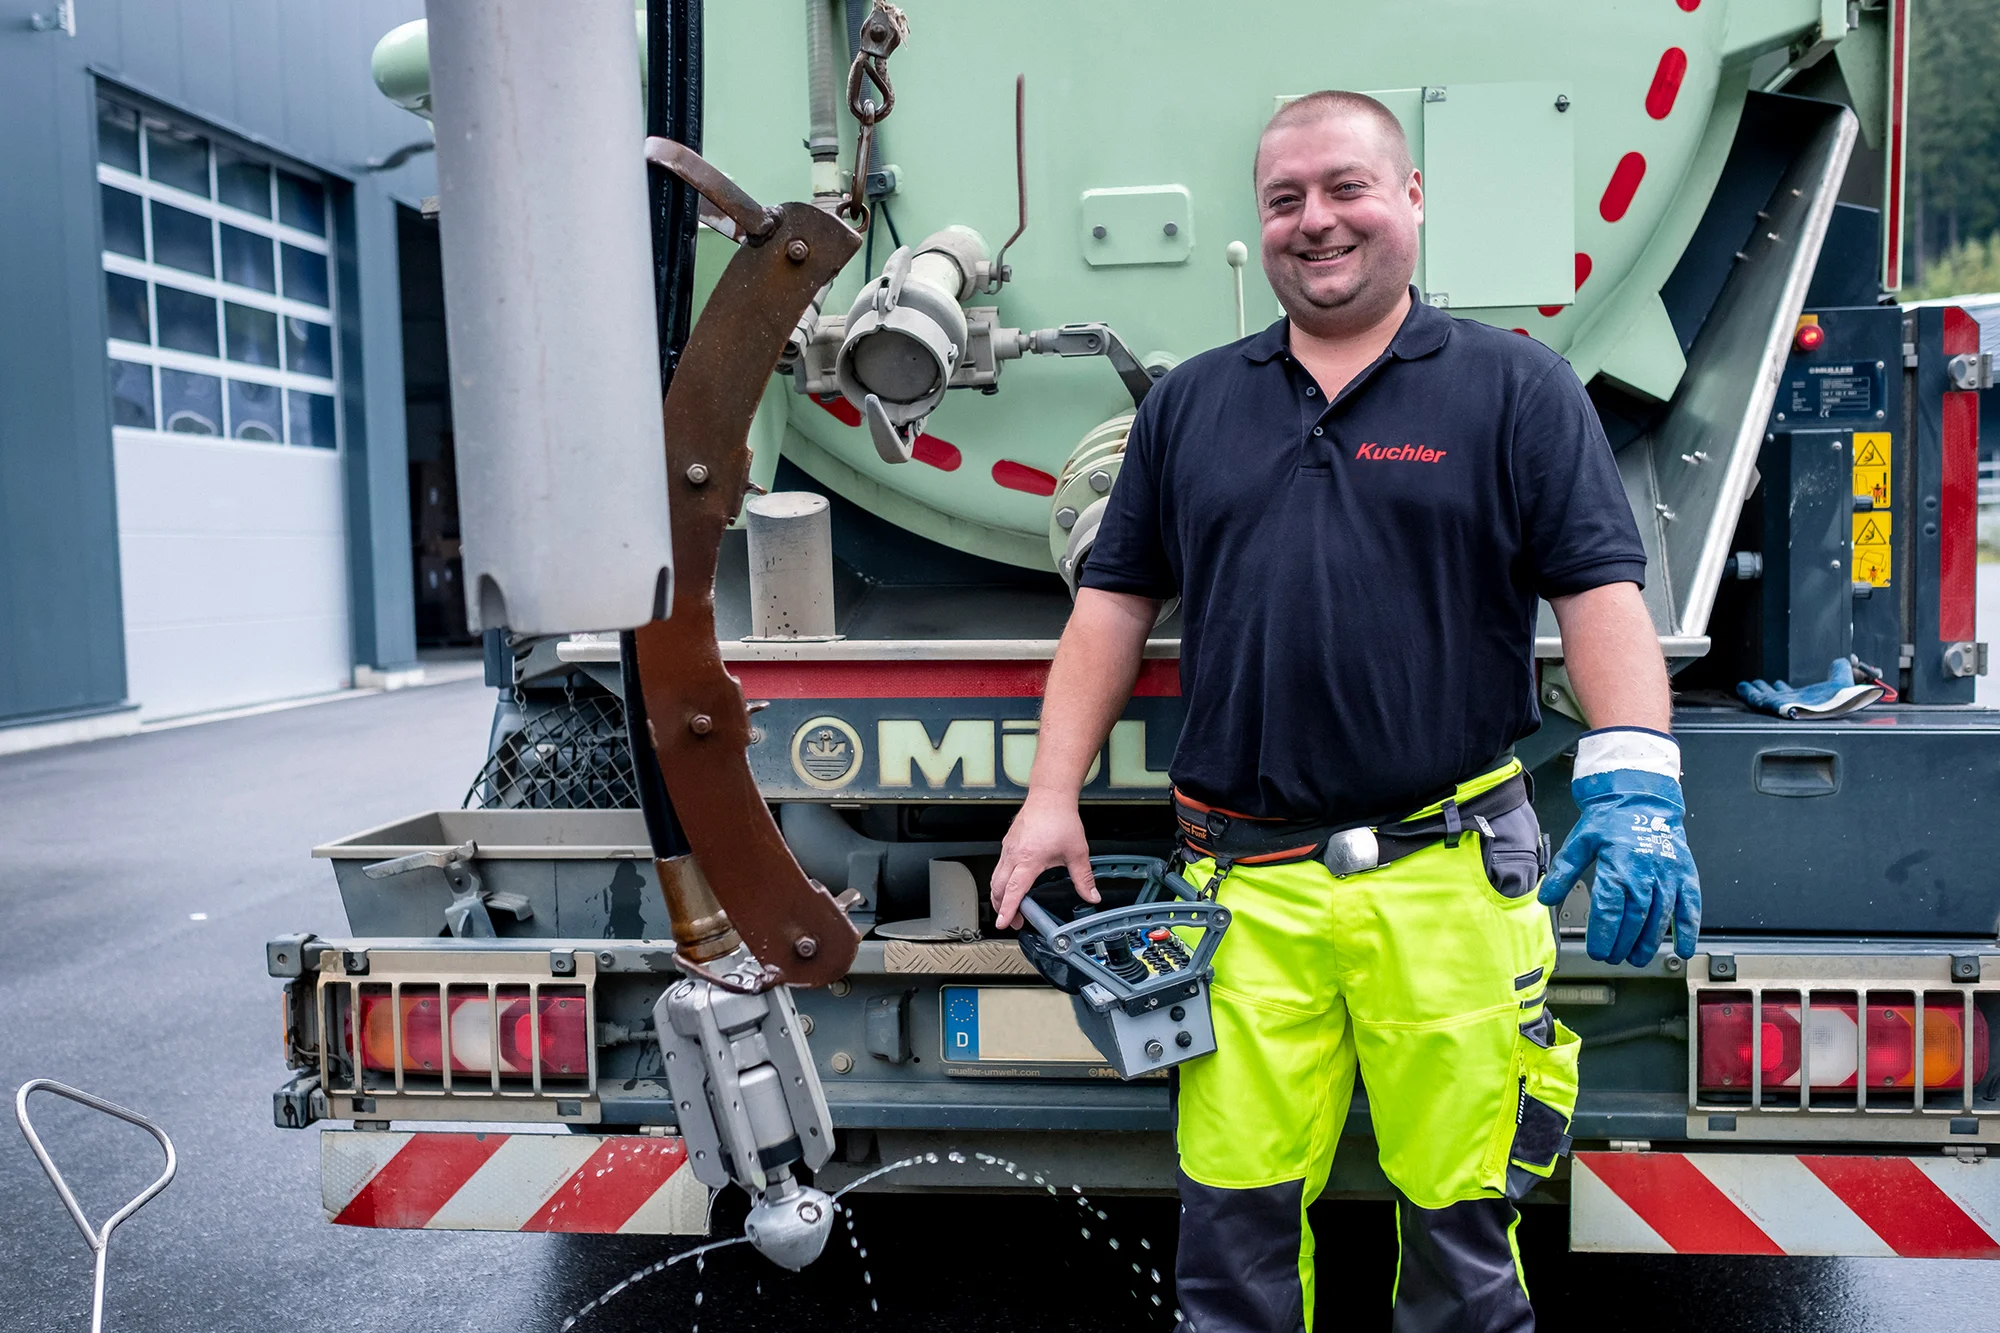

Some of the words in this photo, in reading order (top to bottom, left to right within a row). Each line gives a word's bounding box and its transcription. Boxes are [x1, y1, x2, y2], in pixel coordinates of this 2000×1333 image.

[1355, 442, 1447, 463] Kuchler
[956, 1031, 969, 1047] D
[948, 1067, 1040, 1077] mueller-umwelt.com
